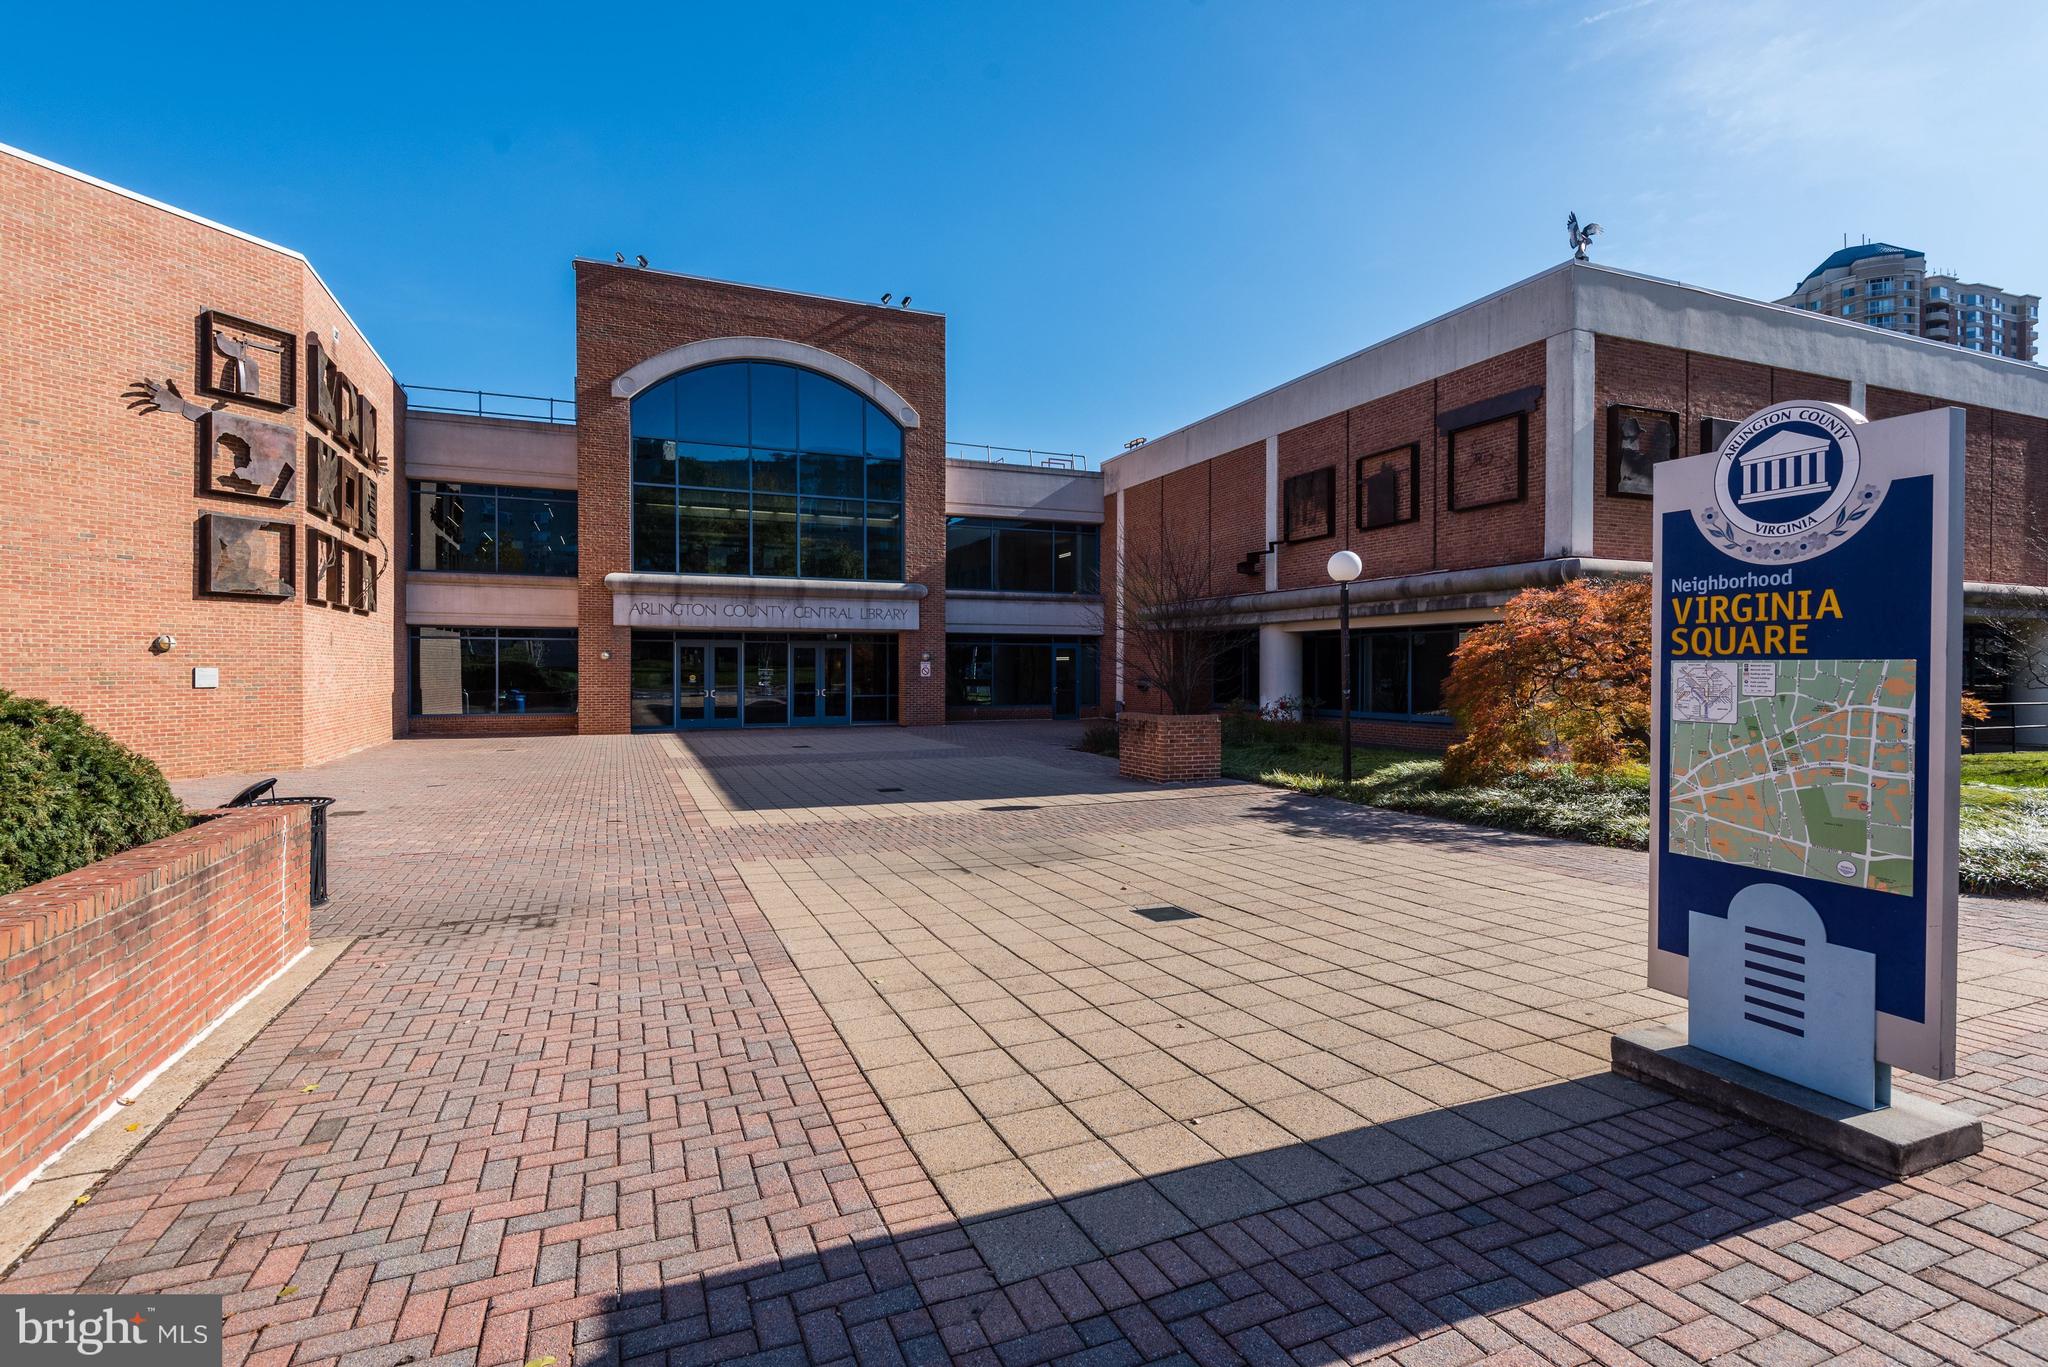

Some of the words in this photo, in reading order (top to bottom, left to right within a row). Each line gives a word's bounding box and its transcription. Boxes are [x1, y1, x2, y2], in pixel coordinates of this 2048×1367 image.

[1724, 410, 1792, 461] ARLINGTON
[1799, 409, 1851, 441] COUNTY
[1755, 516, 1818, 535] VIRGINIA
[1671, 568, 1793, 594] Neighborhood
[629, 602, 717, 616] ARLINGTON
[723, 604, 787, 618] COUNTY
[793, 606, 853, 619] CENTRAL
[860, 607, 909, 620] LIBRARY
[1671, 588, 1843, 625] VIRGINIA
[1670, 623, 1809, 656] SQUARE
